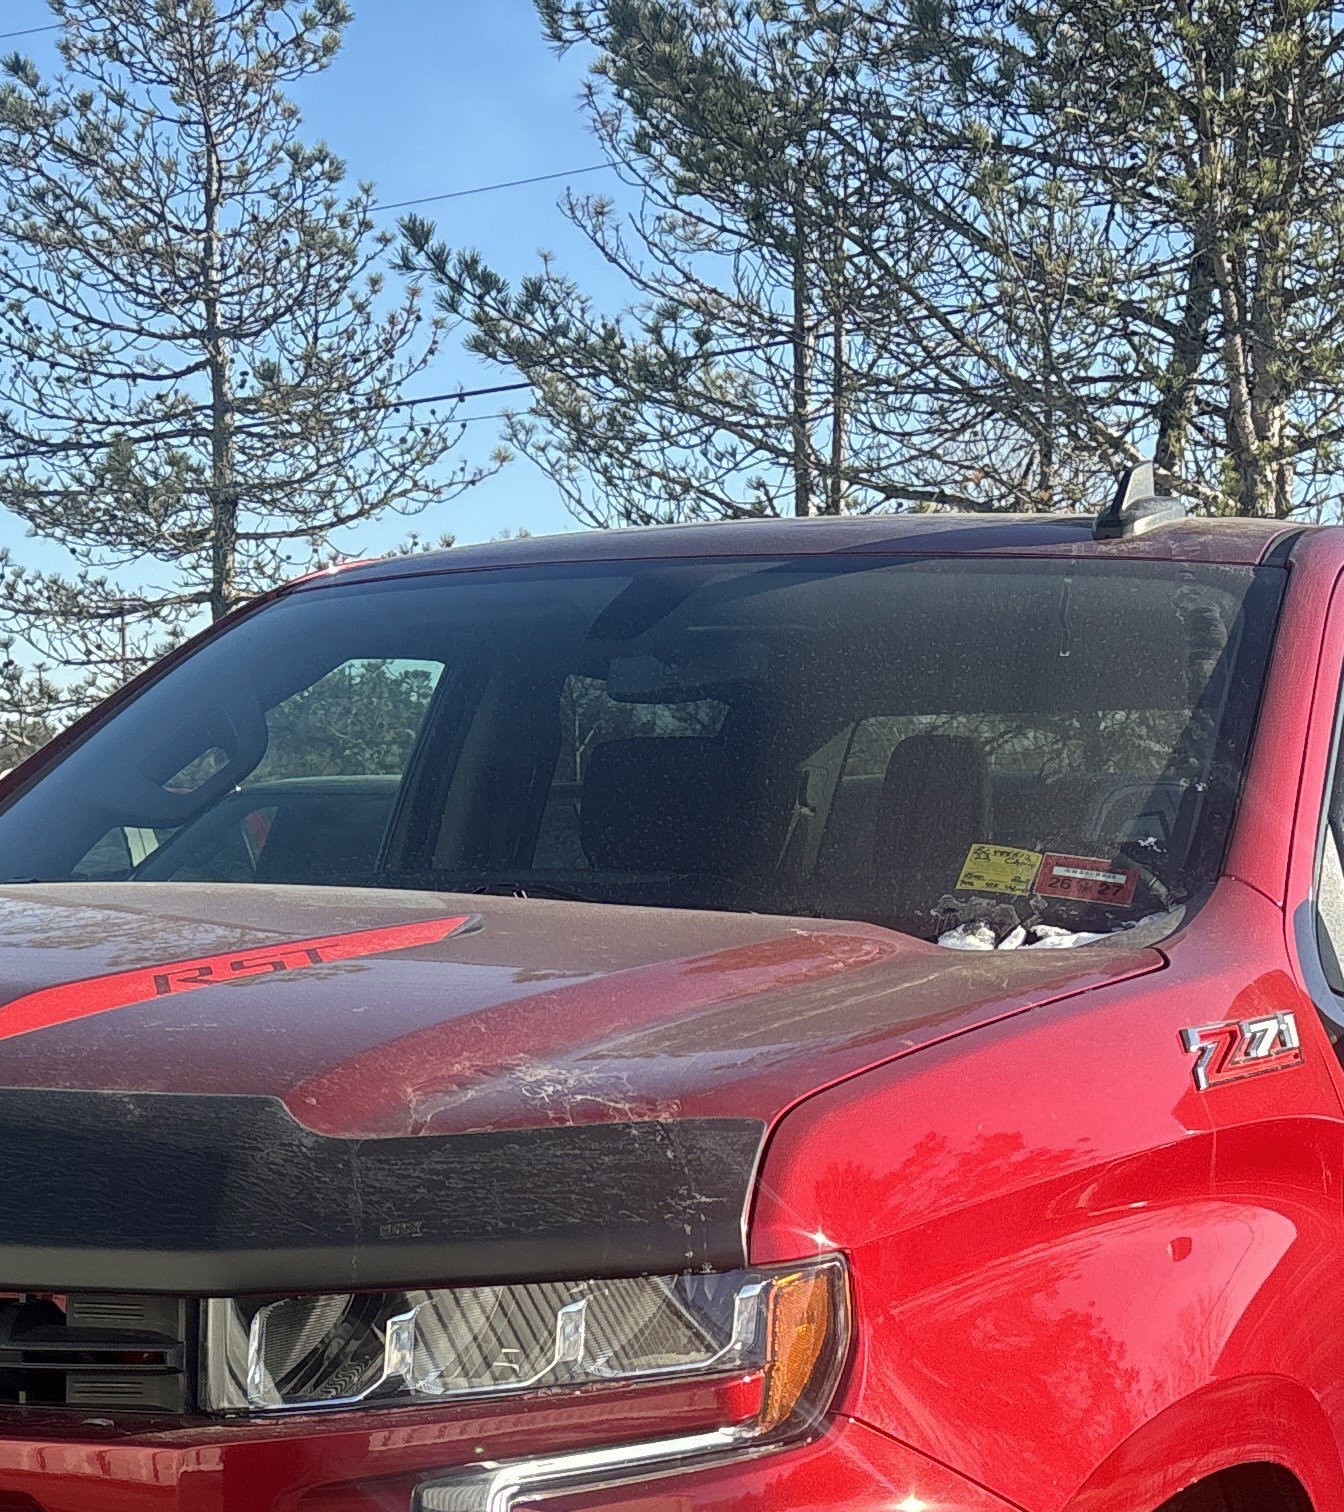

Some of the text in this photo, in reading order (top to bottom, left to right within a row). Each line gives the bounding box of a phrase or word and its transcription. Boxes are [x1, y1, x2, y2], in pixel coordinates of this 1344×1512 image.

[1047, 877, 1072, 890] 26
[1097, 882, 1125, 896] 27
[154, 943, 340, 995] RST
[1179, 1010, 1303, 1091] Z71
